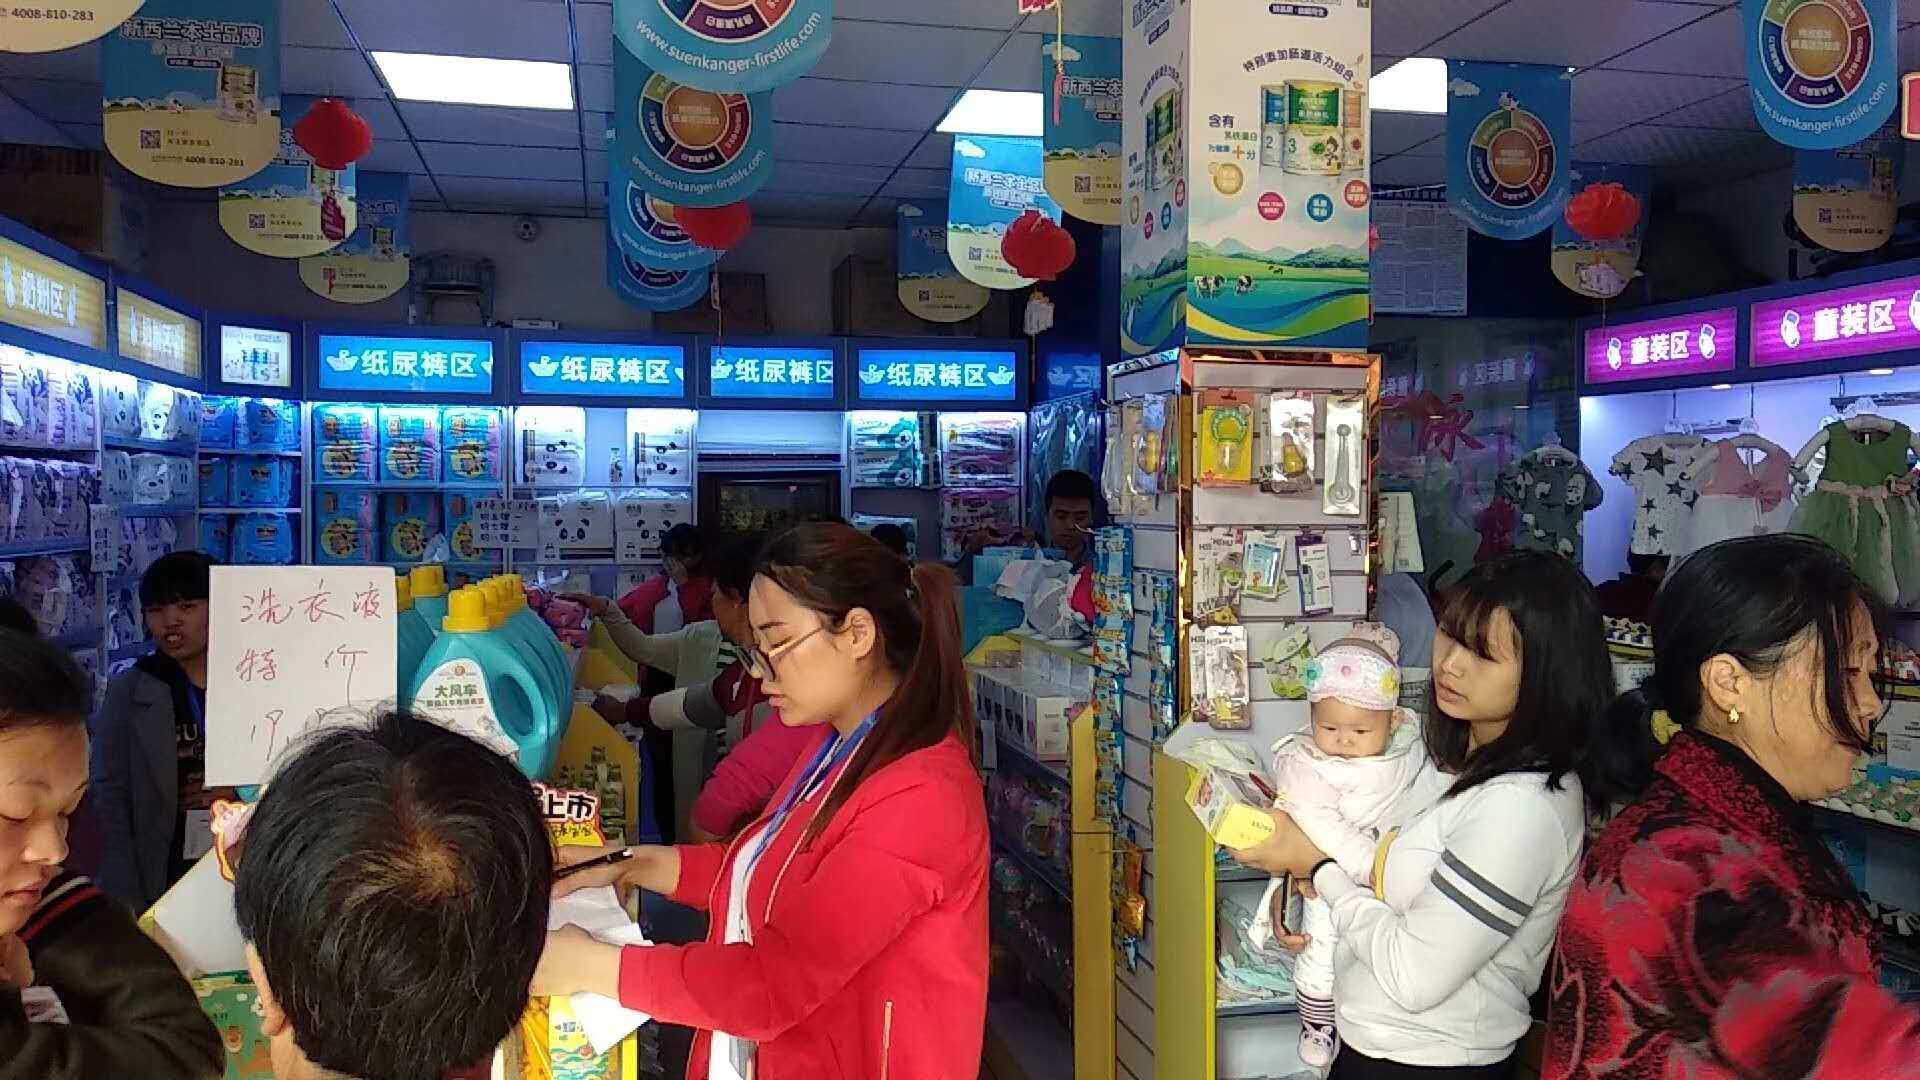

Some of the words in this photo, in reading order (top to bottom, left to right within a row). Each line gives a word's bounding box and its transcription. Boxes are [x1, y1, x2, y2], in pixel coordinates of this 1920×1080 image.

[123, 20, 262, 46] 新西兰本土品牌
[636, 11, 821, 75] www.suenkanger-firstlife.com
[1208, 114, 1235, 129] 含有
[1753, 81, 1888, 134] www.suenkanger-firstlife.com
[631, 149, 768, 195] www.suenkanger-firstlife.com
[1812, 298, 1896, 341] 童装区
[361, 348, 478, 378] 纸尿裤区
[1630, 330, 1690, 365] 童装区
[561, 355, 670, 384] 纸尿裤区
[735, 358, 833, 384] 纸尿裤区
[887, 362, 988, 387] 纸尿裤区
[241, 579, 383, 624] 洗衣液
[236, 644, 368, 707] 特价
[434, 683, 478, 698] 大风车
